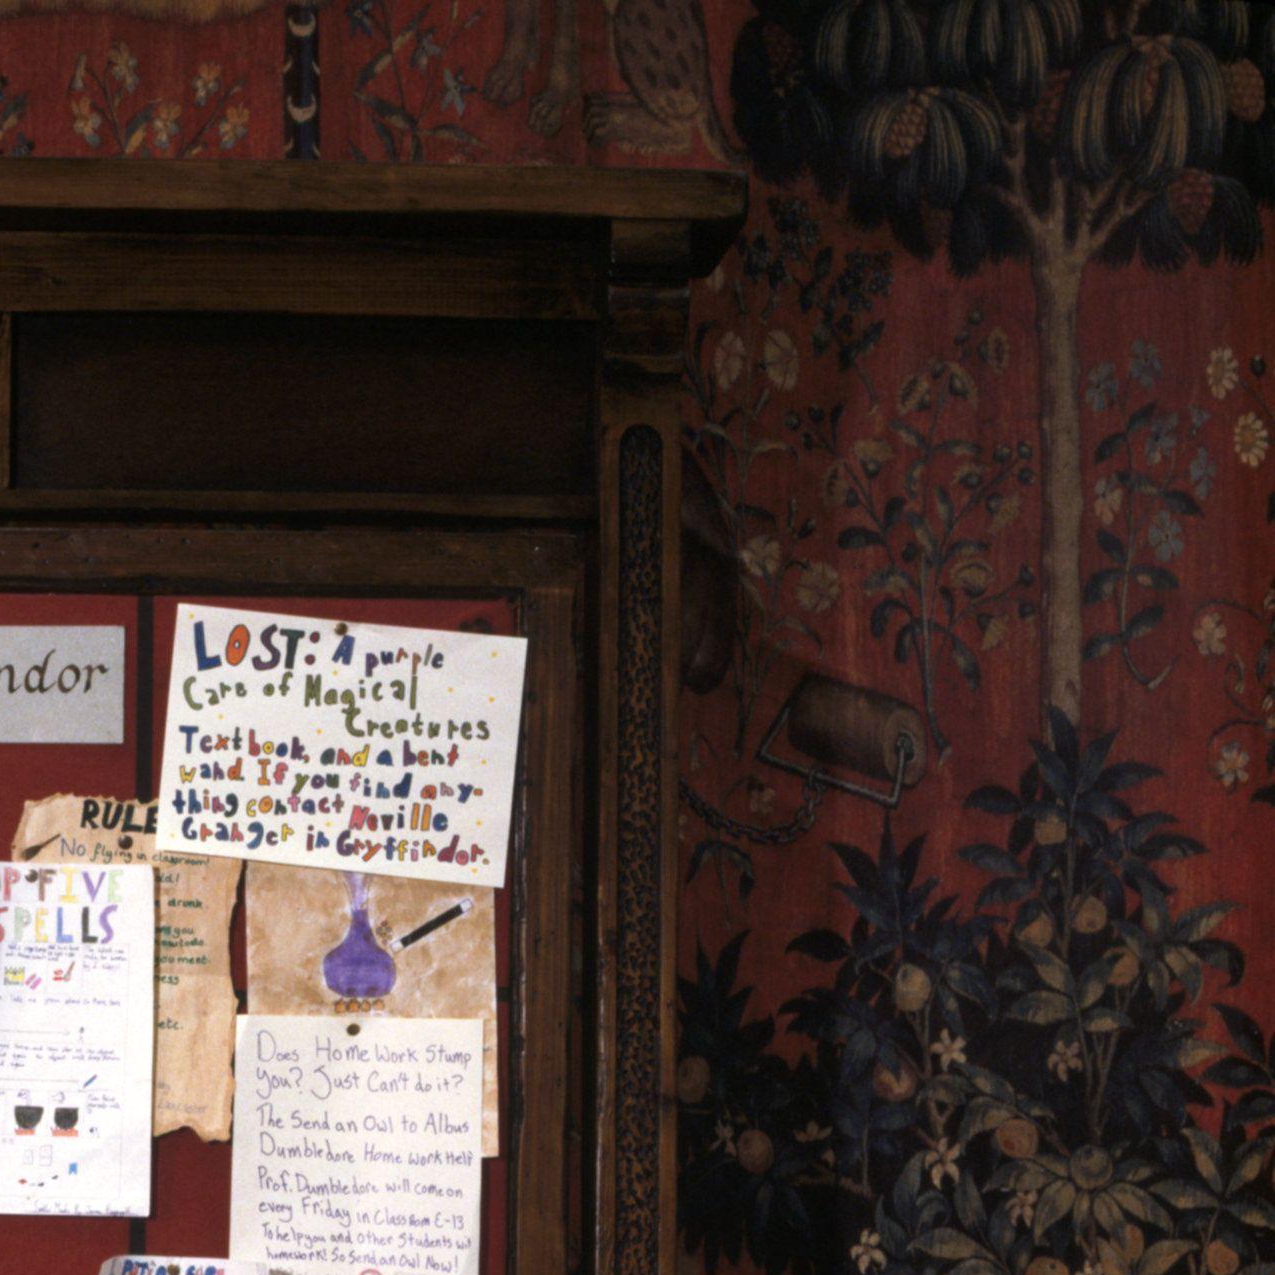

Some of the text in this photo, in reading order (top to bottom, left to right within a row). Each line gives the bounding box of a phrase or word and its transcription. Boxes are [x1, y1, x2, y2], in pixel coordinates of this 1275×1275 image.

[193, 621, 445, 677] LOST: A purple
[183, 670, 418, 712] Care of Magical
[345, 709, 490, 740] Creatures
[320, 744, 370, 768] and
[376, 749, 394, 767] a
[403, 740, 459, 767] bent
[257, 758, 289, 786] If
[293, 772, 340, 796] you
[349, 772, 413, 798] find
[172, 789, 449, 832] thing contact Neville
[60, 838, 86, 857] No
[89, 843, 134, 863] flying
[136, 852, 147, 862] in
[181, 816, 490, 866] Granger in Gryffindor.
[38, 866, 124, 904] FIVE
[257, 1030, 473, 1071] Does Home Work Stump
[311, 1065, 360, 1100] Just
[367, 1071, 409, 1093] Can't
[414, 1078, 432, 1093] do
[256, 1102, 470, 1134] The Send an Owl to Albus
[364, 1142, 403, 1164] Home
[385, 1177, 410, 1194] will
[258, 1200, 293, 1223] every
[302, 1195, 352, 1227] Friday
[357, 1211, 371, 1225] in
[330, 1229, 353, 1245] and
[348, 1250, 376, 1265] Send
[379, 1254, 396, 1266] an
[398, 1252, 420, 1268] Owl
